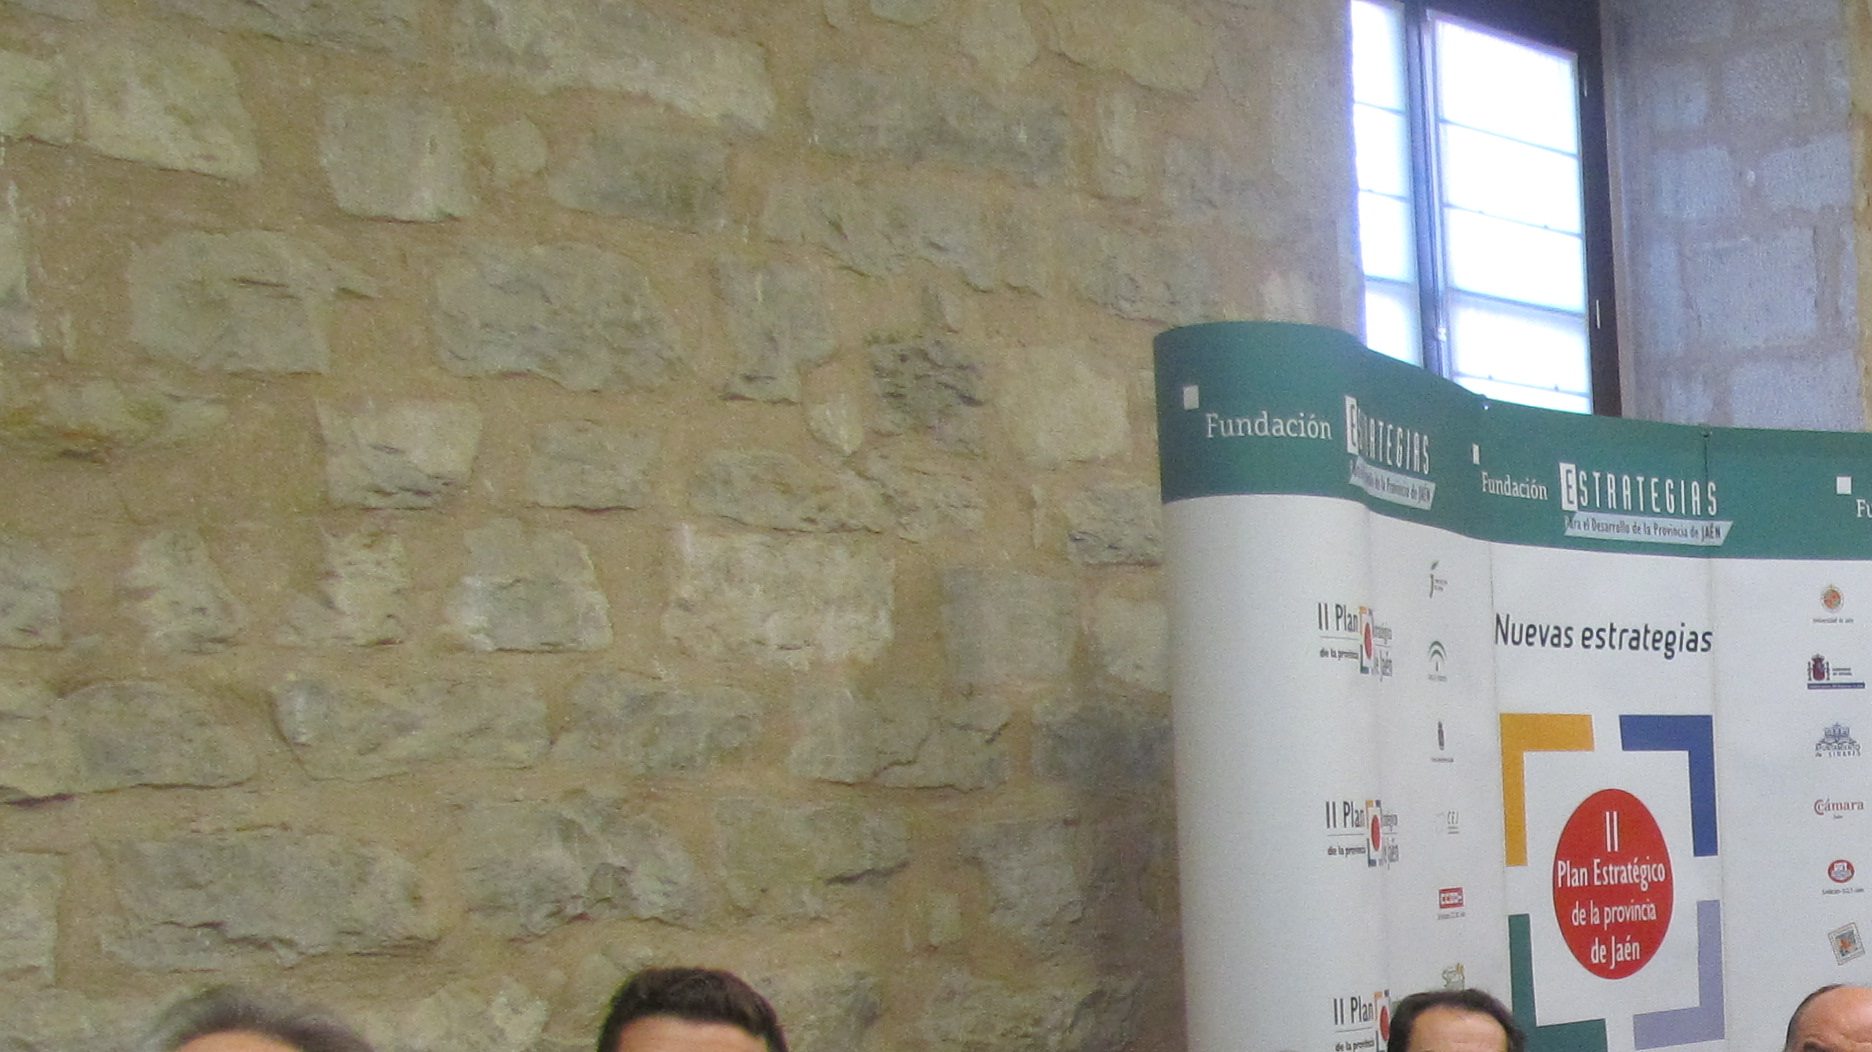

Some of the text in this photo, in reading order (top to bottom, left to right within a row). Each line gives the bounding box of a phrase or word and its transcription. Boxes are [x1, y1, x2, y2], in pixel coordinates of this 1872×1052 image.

[1206, 411, 1332, 441] Fundación
[1481, 465, 1718, 516] Fundación ESTRATEGIAS
[1583, 517, 1591, 531] el
[1591, 518, 1631, 535] Desarrollo
[1632, 521, 1642, 535] de
[1643, 521, 1652, 536] la
[1653, 523, 1689, 539] Provincia
[1690, 525, 1700, 538] de
[1701, 523, 1722, 542] JAÉN
[1318, 602, 1358, 633] II Plan
[1494, 613, 1714, 660] Nuevas estrategias
[1325, 801, 1337, 829] II
[1343, 800, 1365, 829] Plan
[1814, 795, 1865, 816] Cámara
[1605, 811, 1620, 853] II
[1557, 856, 1666, 892] Plan Estratégico
[1571, 898, 1657, 930] de la provincia
[1590, 936, 1641, 970] de Jaén
[1333, 995, 1374, 1026] II Plan
